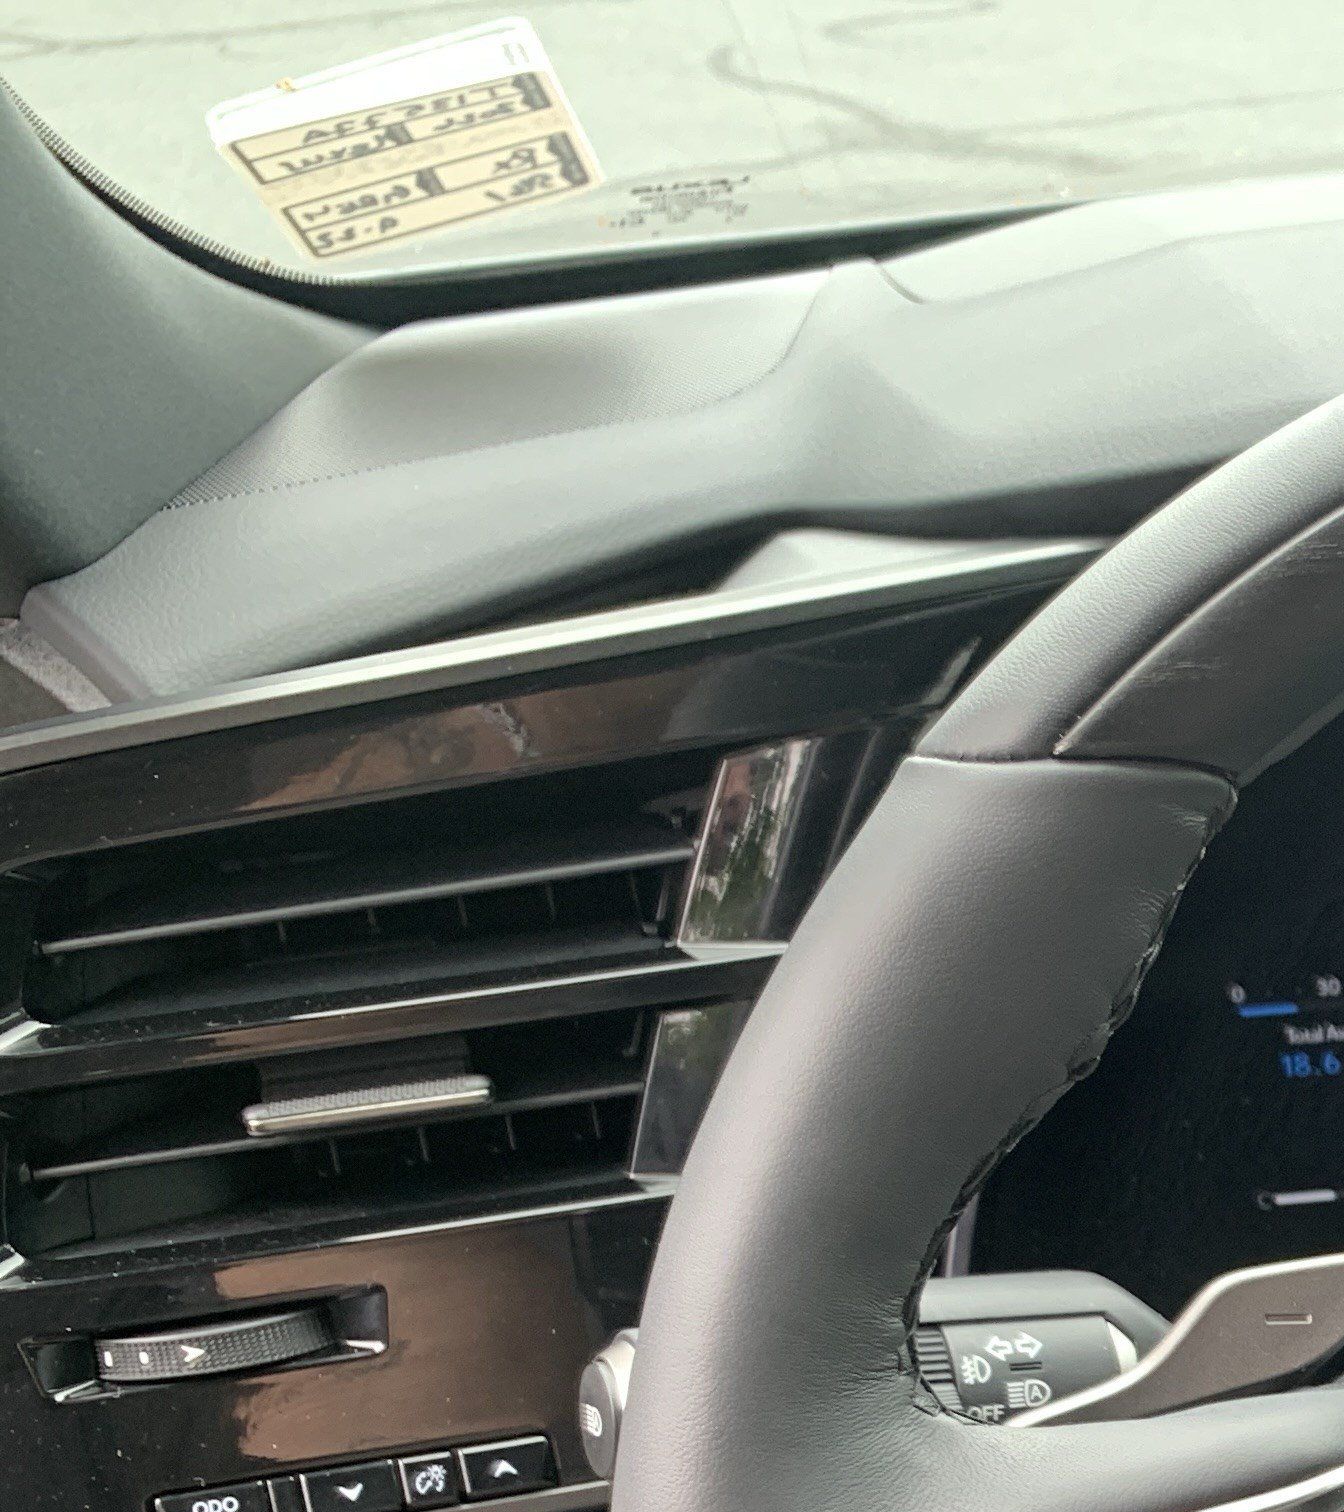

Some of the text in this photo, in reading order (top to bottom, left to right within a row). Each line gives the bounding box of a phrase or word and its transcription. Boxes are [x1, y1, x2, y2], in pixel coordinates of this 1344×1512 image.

[1230, 983, 1246, 1003] 0
[1316, 974, 1342, 998] 30
[1283, 1022, 1324, 1045] Total
[1279, 1051, 1342, 1078] 18.6
